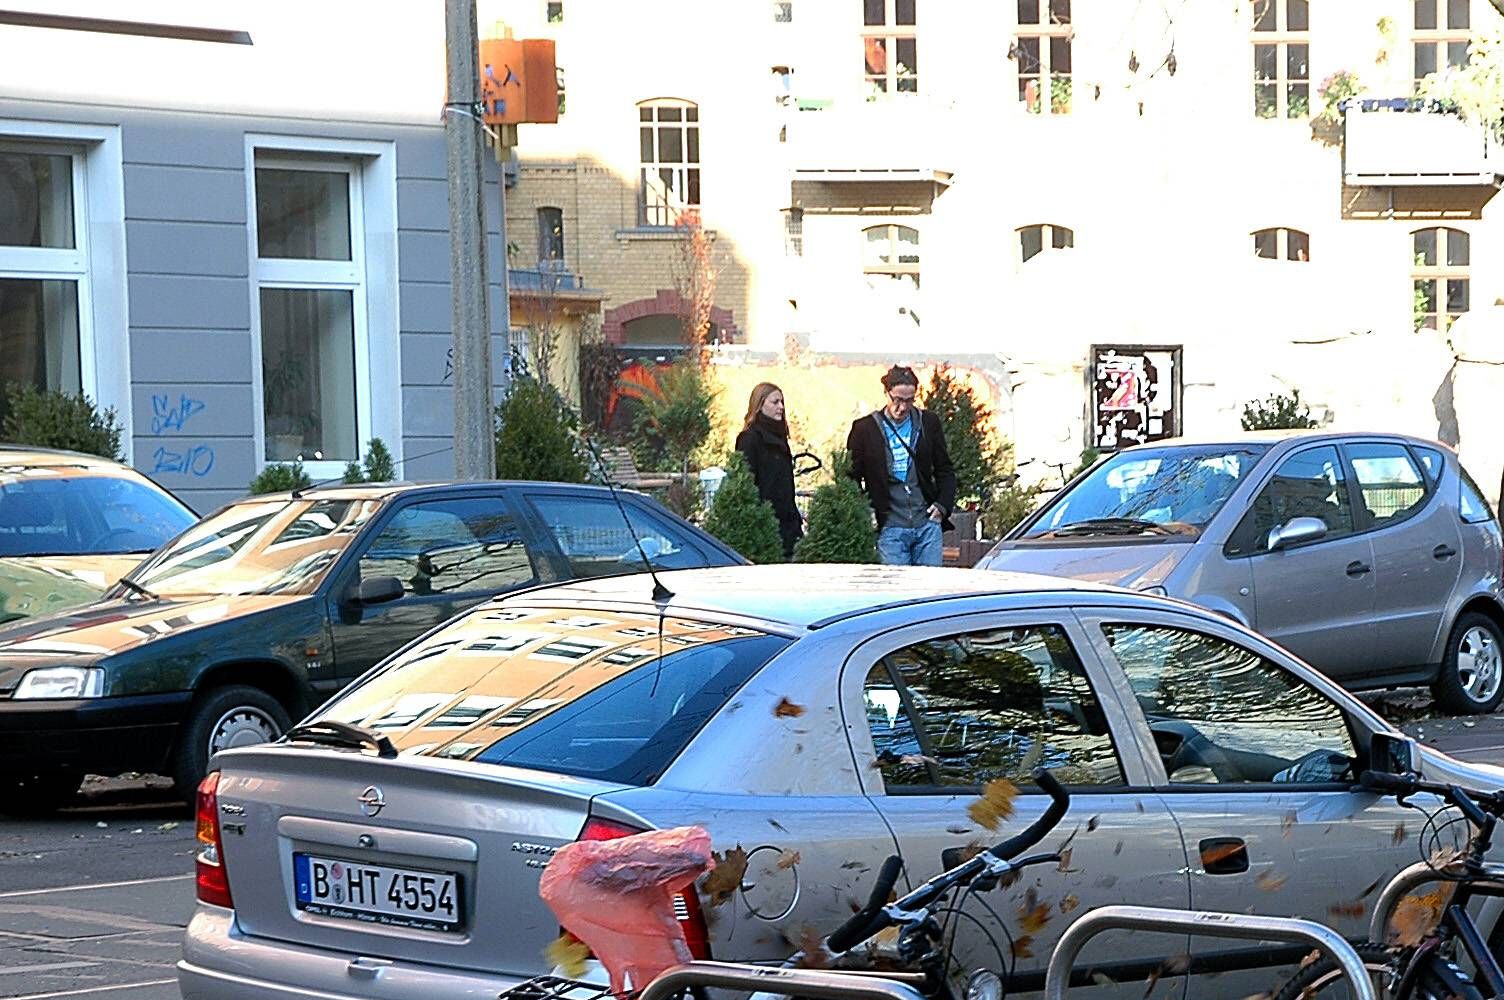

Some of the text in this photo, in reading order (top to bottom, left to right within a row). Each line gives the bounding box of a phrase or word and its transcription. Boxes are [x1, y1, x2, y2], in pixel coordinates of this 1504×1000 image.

[313, 862, 454, 916] B HT 4554
